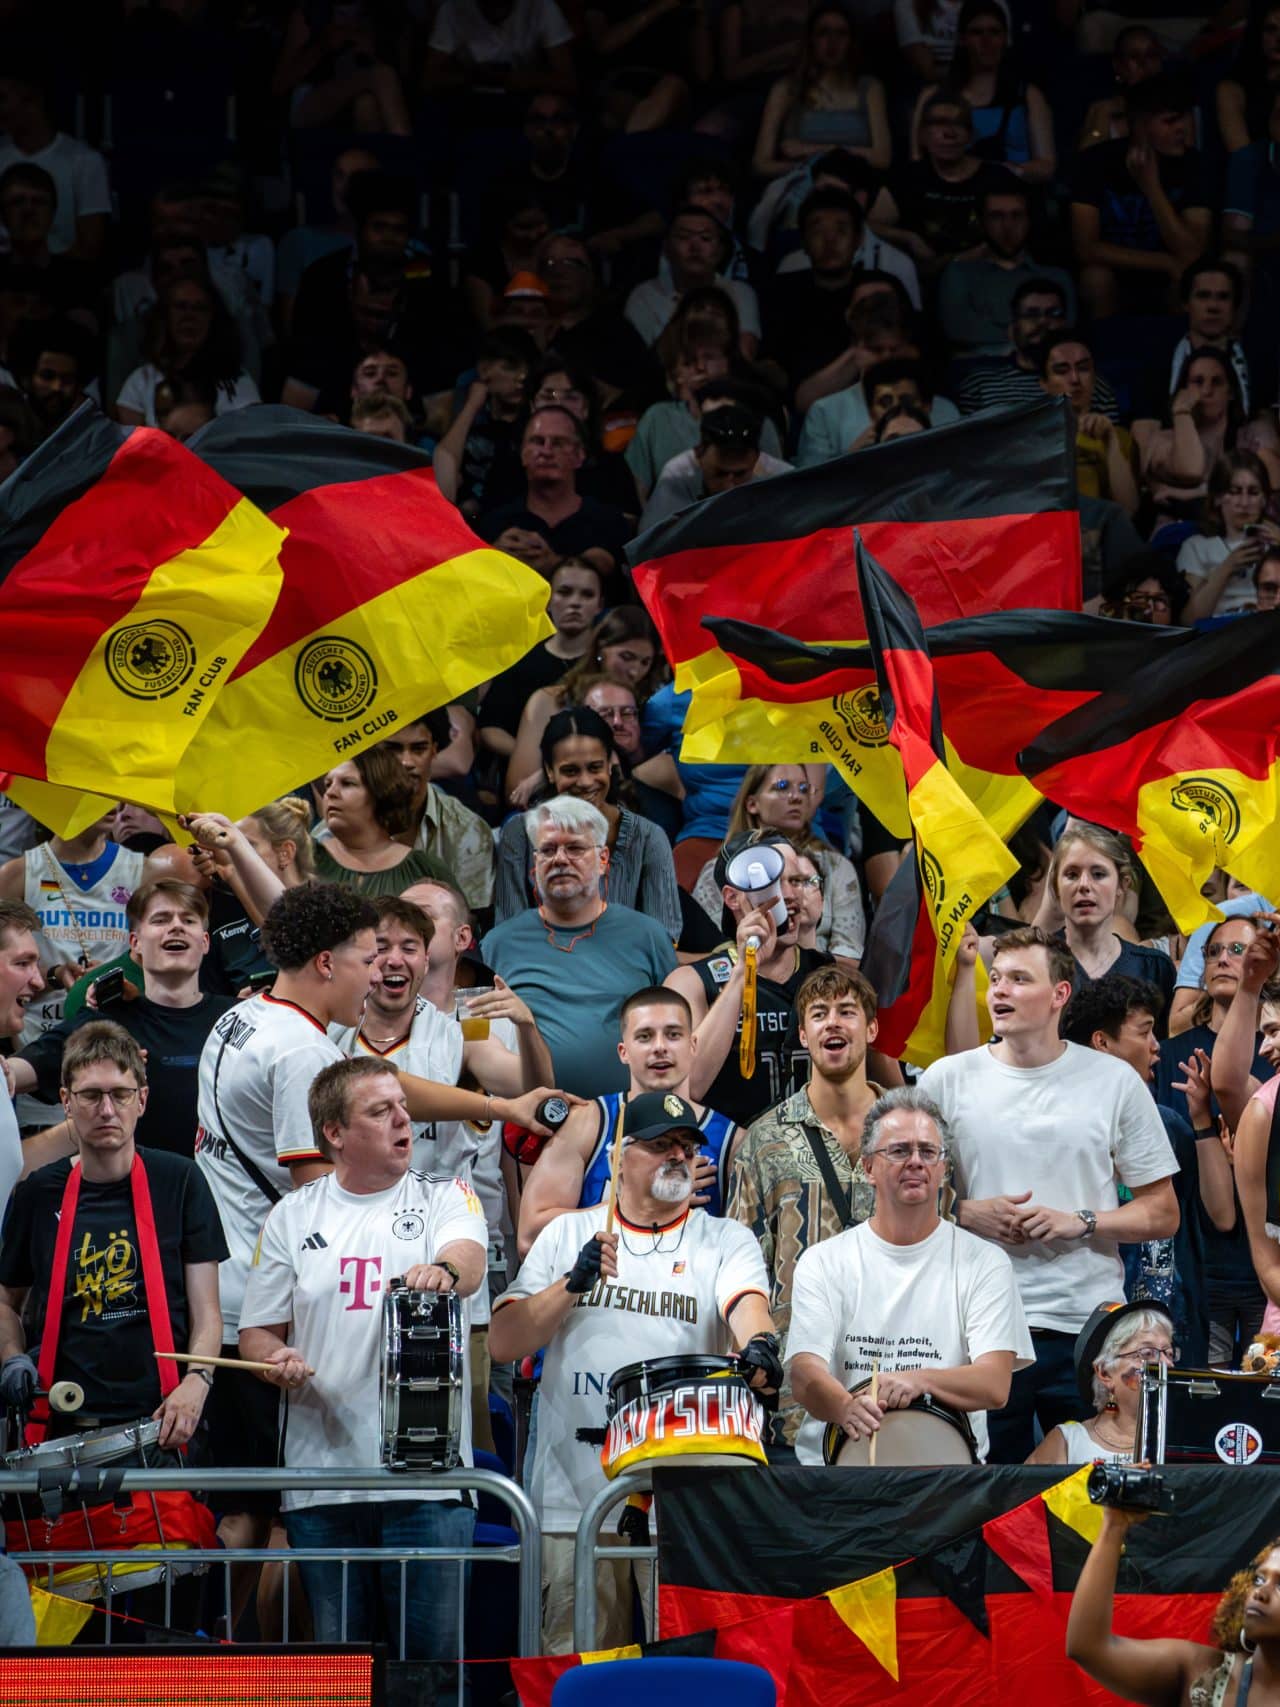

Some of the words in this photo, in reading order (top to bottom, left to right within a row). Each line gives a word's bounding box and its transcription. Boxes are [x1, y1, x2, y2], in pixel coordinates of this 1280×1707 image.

[183, 688, 207, 717] FAN
[199, 656, 228, 687] CLUB
[333, 730, 362, 752] FAN
[362, 709, 398, 736] CLUB
[575, 1283, 698, 1324] EUTSCHLAND
[845, 1334, 885, 1345] Fussball
[898, 1336, 933, 1347] Arbeit,
[859, 1347, 882, 1358] Tennis
[897, 1348, 942, 1360] Handwerk,
[845, 1361, 881, 1371] Basketbal
[572, 1372, 611, 1395] IN
